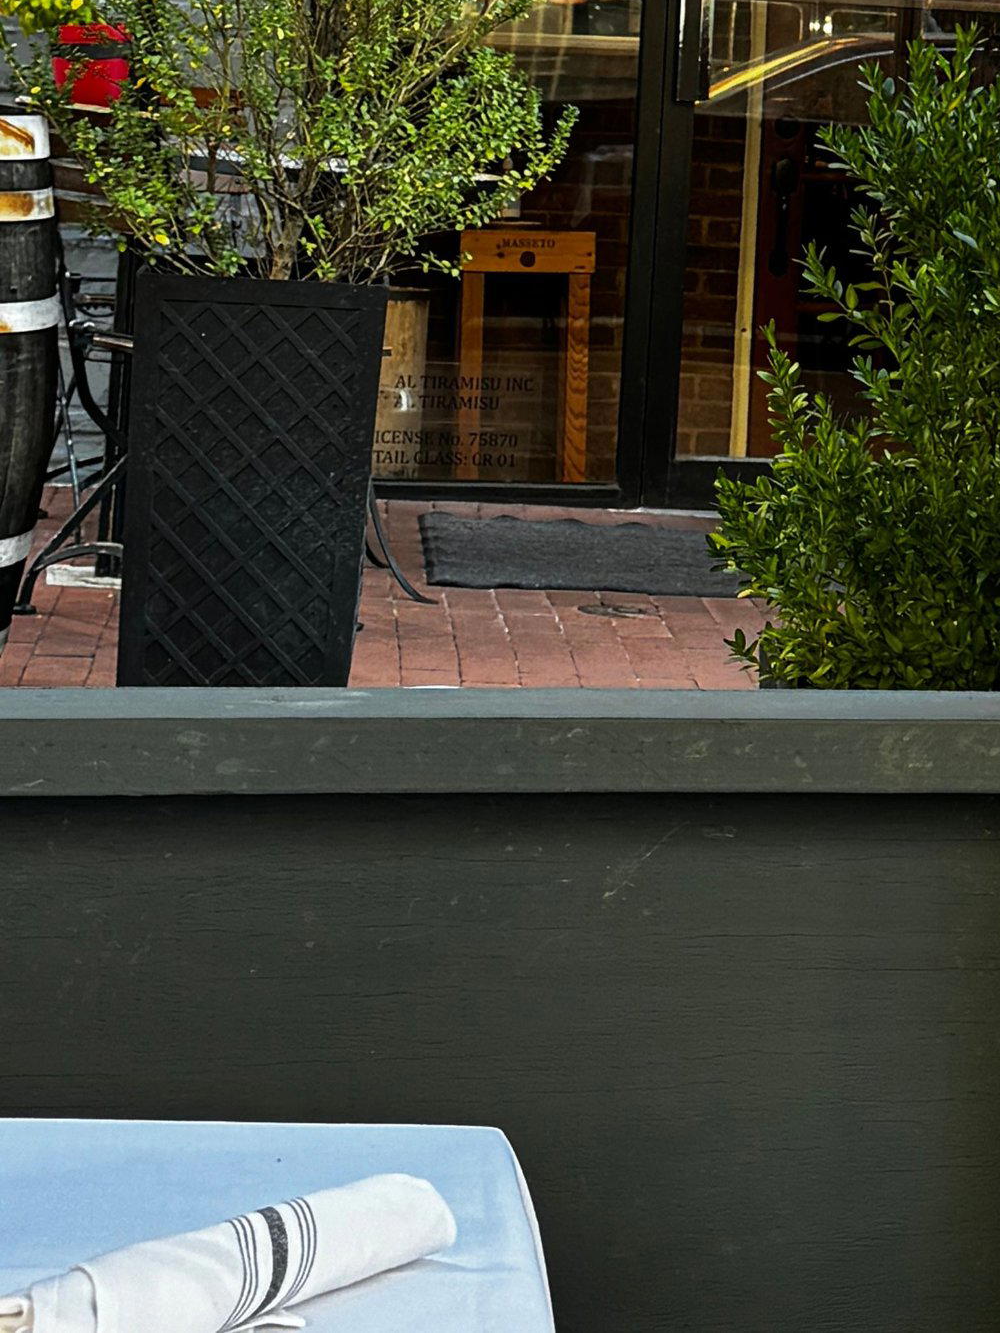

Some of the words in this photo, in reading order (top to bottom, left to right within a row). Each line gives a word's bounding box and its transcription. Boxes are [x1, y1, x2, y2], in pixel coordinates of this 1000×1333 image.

[395, 375, 416, 389] AL
[422, 376, 501, 391] TIRAMISU
[506, 378, 534, 392] INC
[419, 395, 500, 410] TIRAMISU
[374, 430, 434, 445] ICENSE
[373, 450, 409, 464] TAIL
[414, 451, 468, 466] CLASS:
